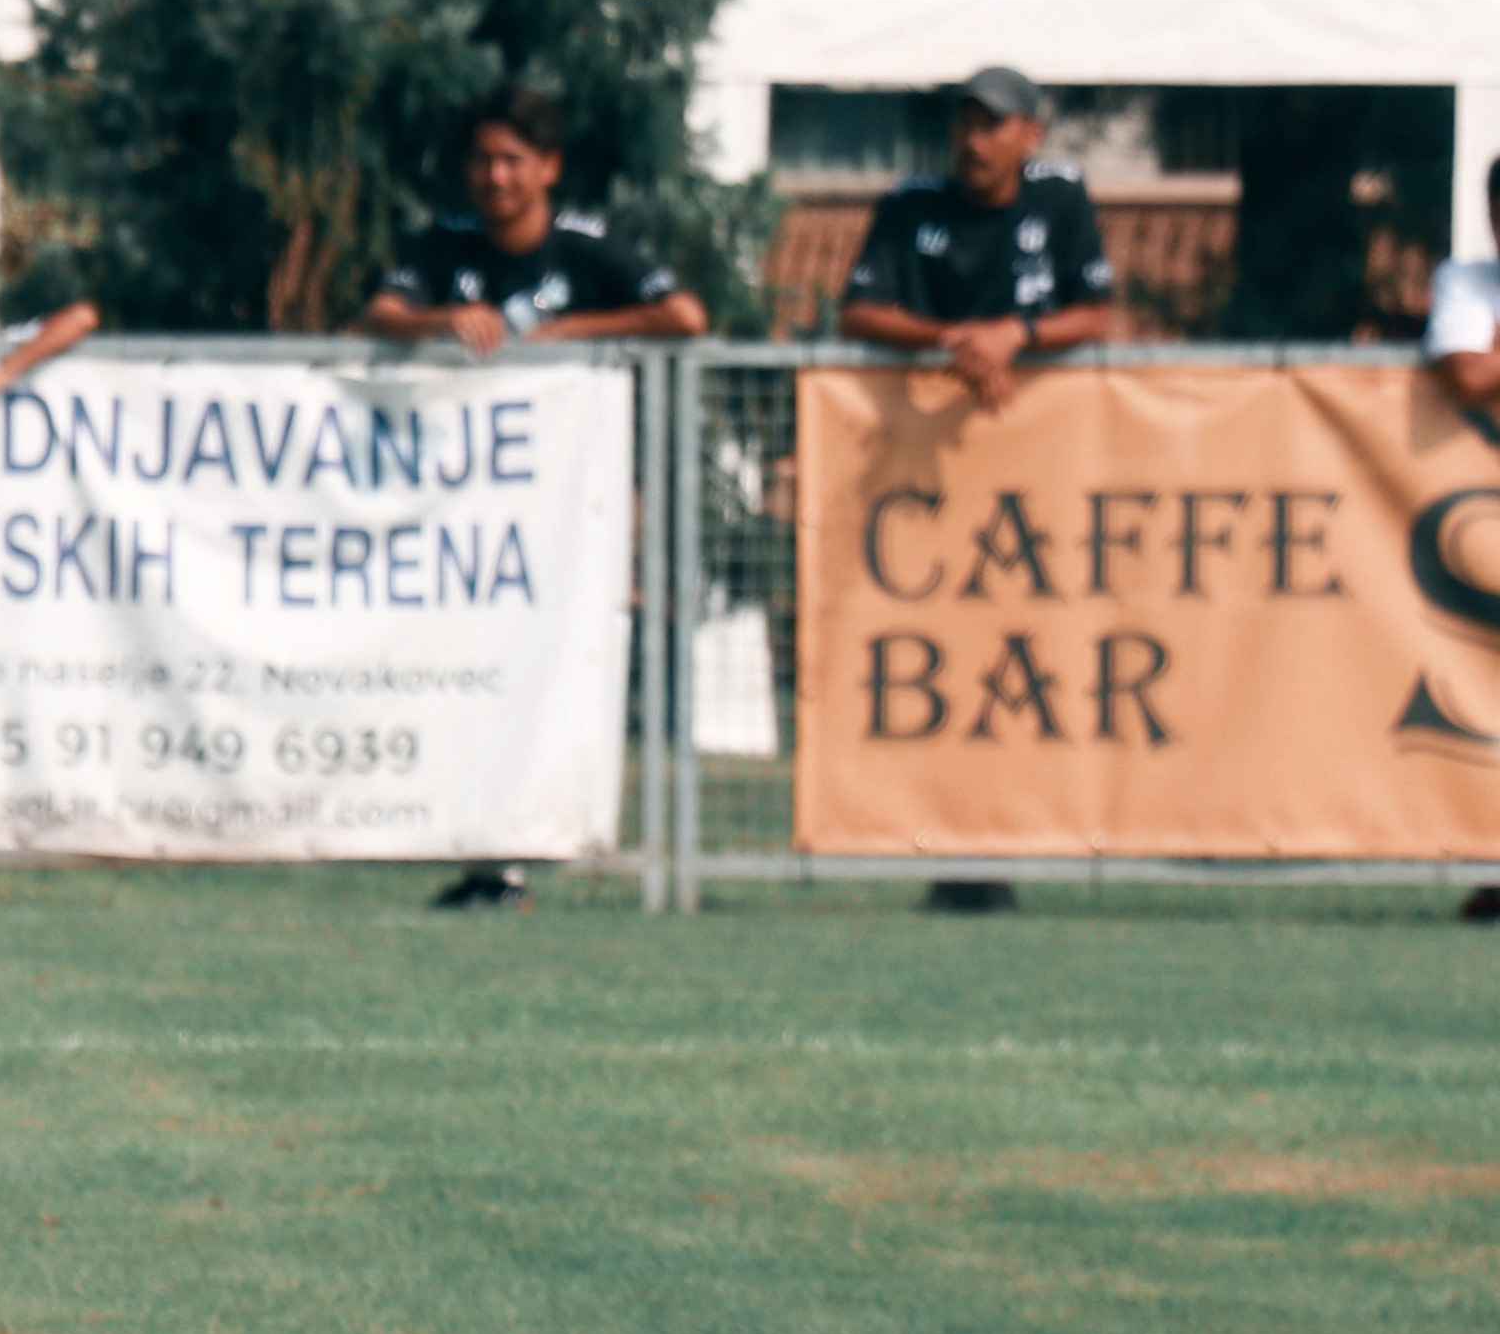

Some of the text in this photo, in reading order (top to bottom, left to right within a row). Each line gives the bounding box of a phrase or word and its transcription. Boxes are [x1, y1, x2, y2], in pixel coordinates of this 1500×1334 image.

[231, 523, 536, 608] TERENA
[863, 490, 1345, 601] CAFFE
[865, 633, 1174, 744] BAR
[54, 720, 115, 767] 91
[139, 723, 248, 775] 949
[275, 727, 422, 777] 6939
